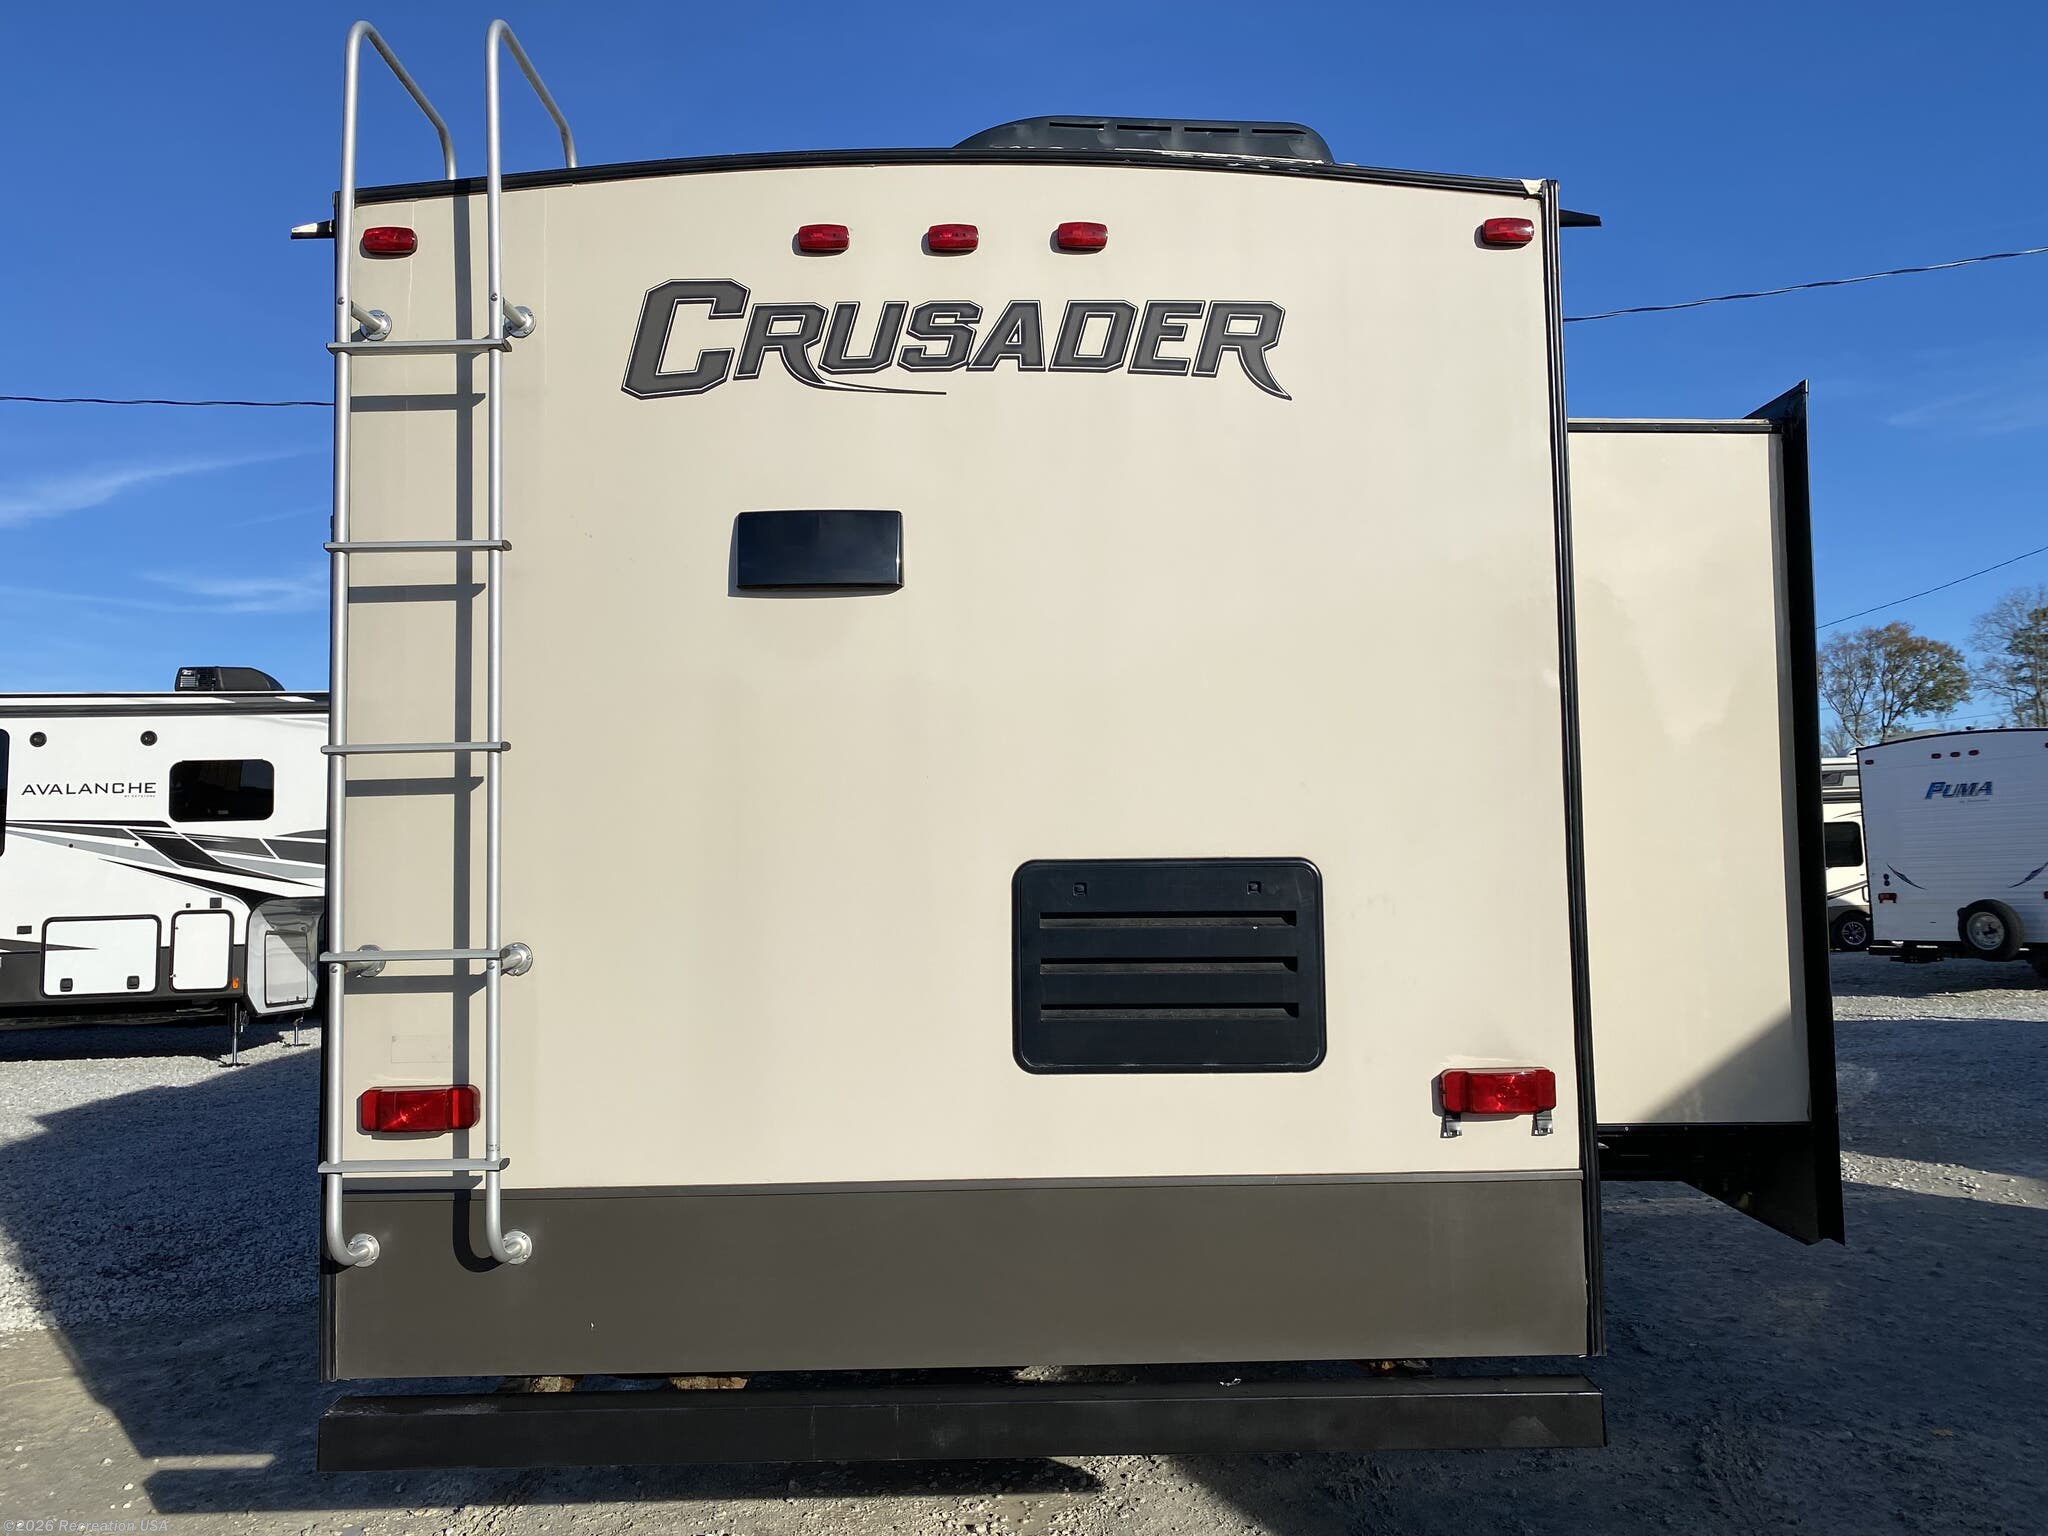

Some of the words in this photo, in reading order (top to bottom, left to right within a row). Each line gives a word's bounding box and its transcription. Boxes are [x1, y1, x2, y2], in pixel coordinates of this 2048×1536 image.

[621, 278, 1292, 401] CRUSADER
[21, 782, 157, 796] AVALANCHE
[1924, 781, 1993, 800] PUMA
